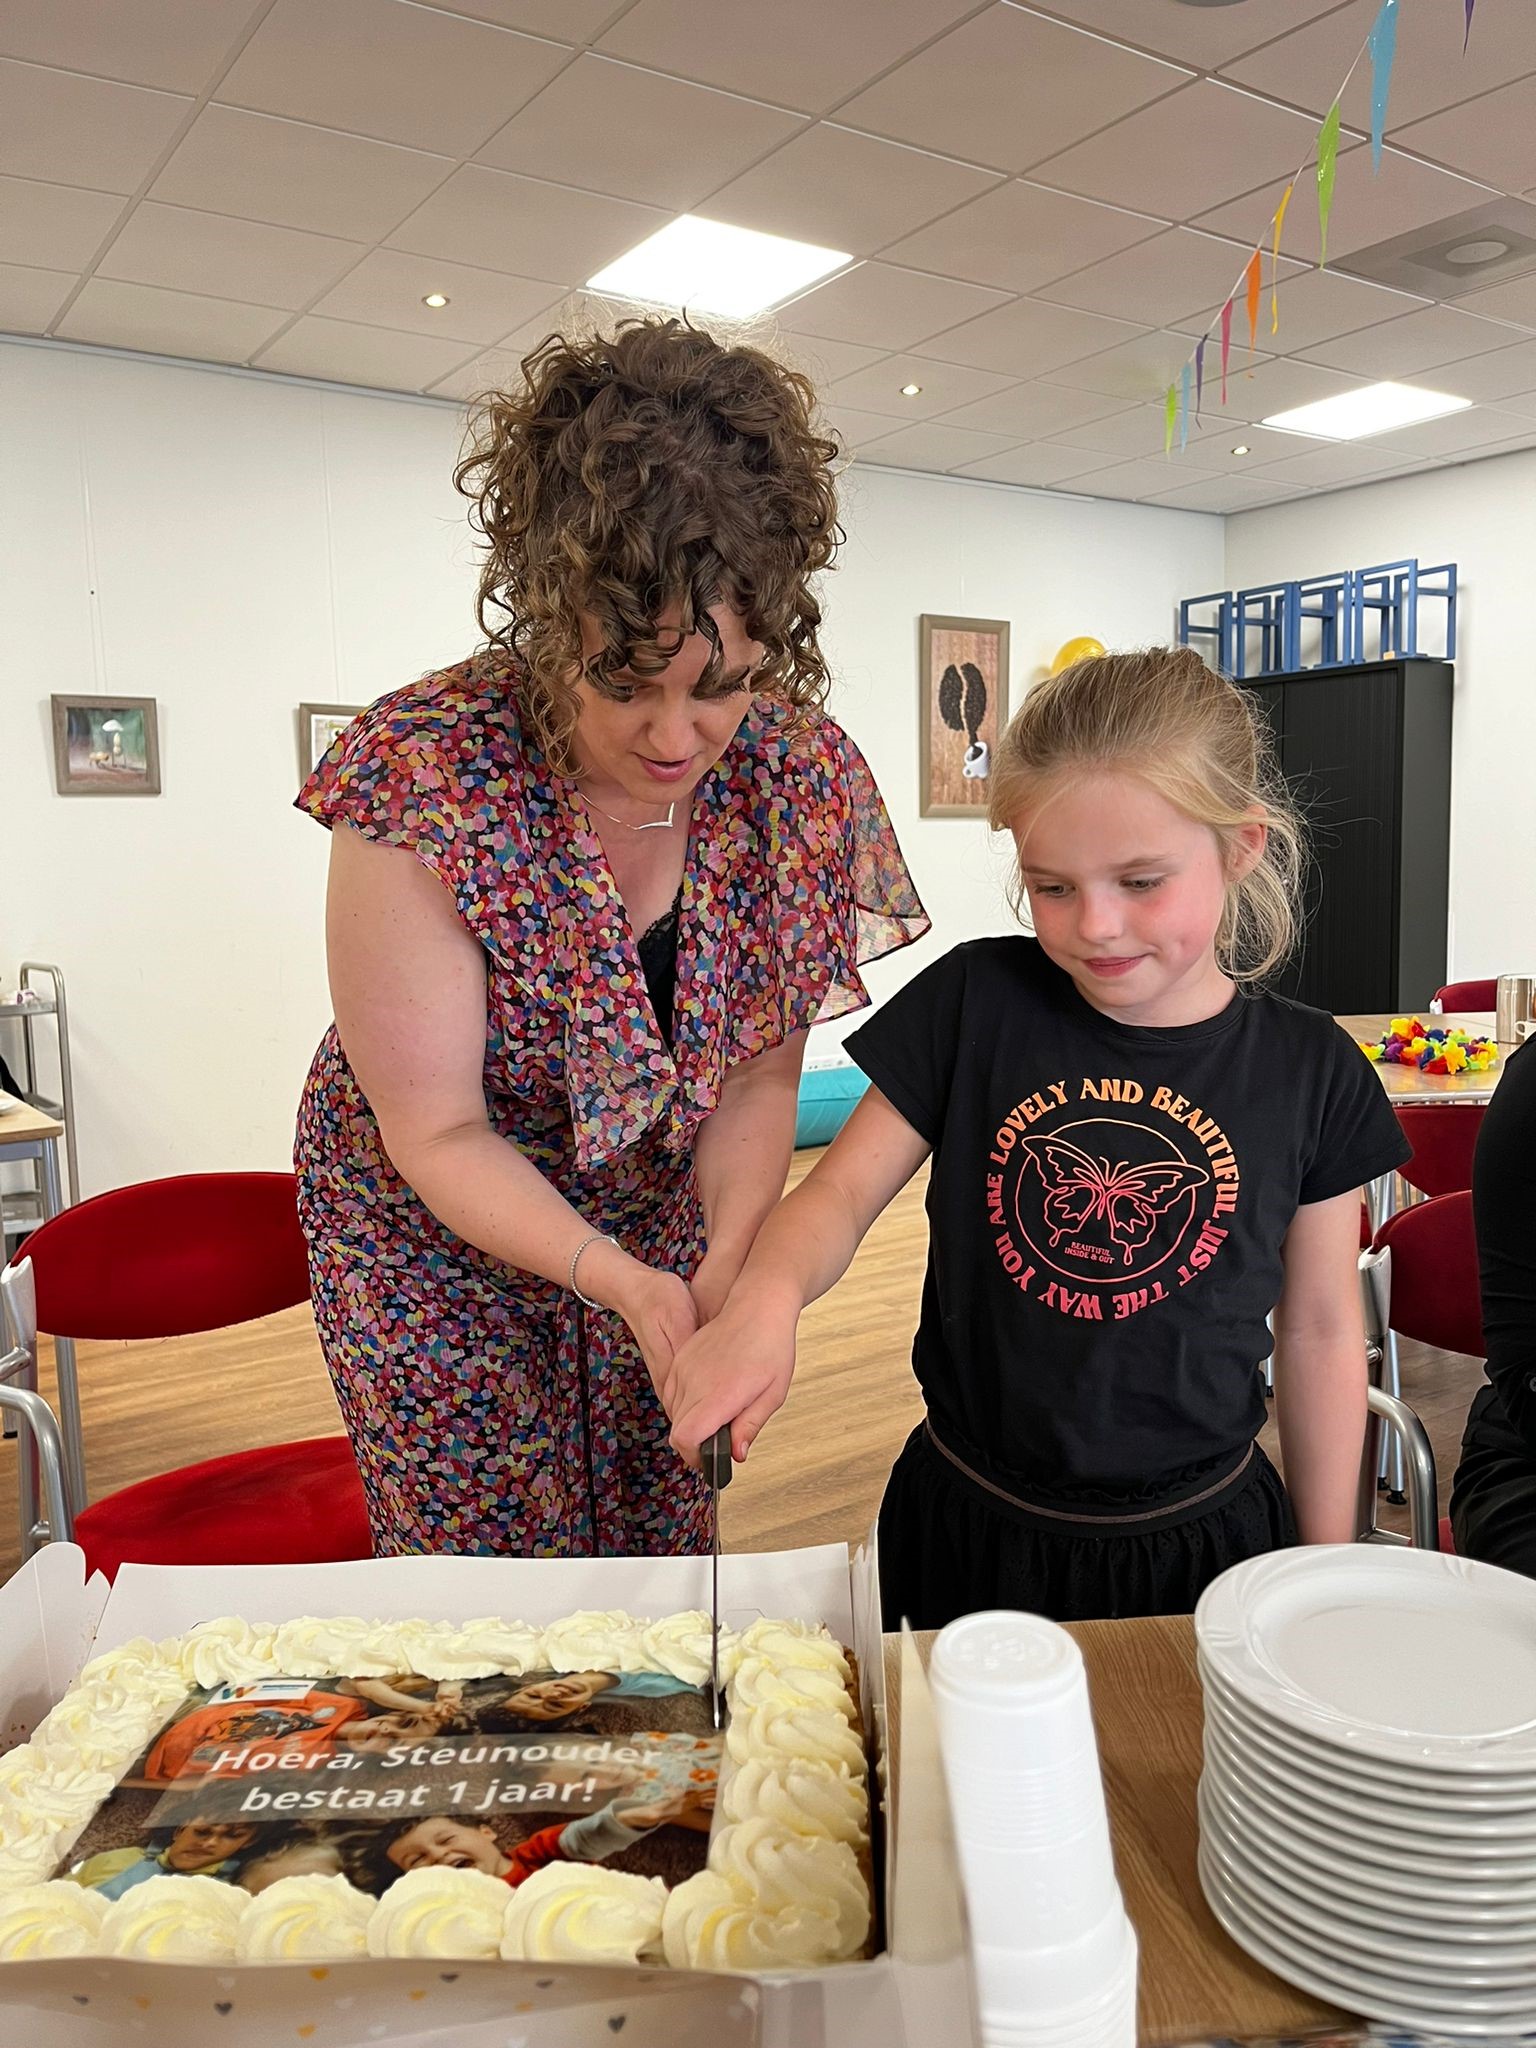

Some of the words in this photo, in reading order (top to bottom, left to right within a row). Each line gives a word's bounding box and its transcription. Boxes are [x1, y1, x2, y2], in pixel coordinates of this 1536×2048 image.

[1080, 1078, 1144, 1104] AND
[990, 1080, 1068, 1165] LOVELY
[1150, 1086, 1239, 1218] BEAUTIFUL
[987, 1173, 1006, 1225] ARE
[995, 1231, 1036, 1292] YOU
[1064, 1247, 1089, 1259] INSIDE
[1090, 1253, 1098, 1261] &
[1098, 1255, 1115, 1264] OUT
[1071, 1241, 1111, 1256] BEAUTIFUL
[1177, 1219, 1229, 1287] JUST
[1037, 1281, 1103, 1320] WAY
[1112, 1281, 1169, 1319] THE
[210, 1748, 365, 1771] Hoera,
[380, 1741, 662, 1768] Steunouder
[240, 1784, 430, 1812] bestaat
[448, 1781, 468, 1804] 1
[474, 1777, 597, 1811] jaar!
